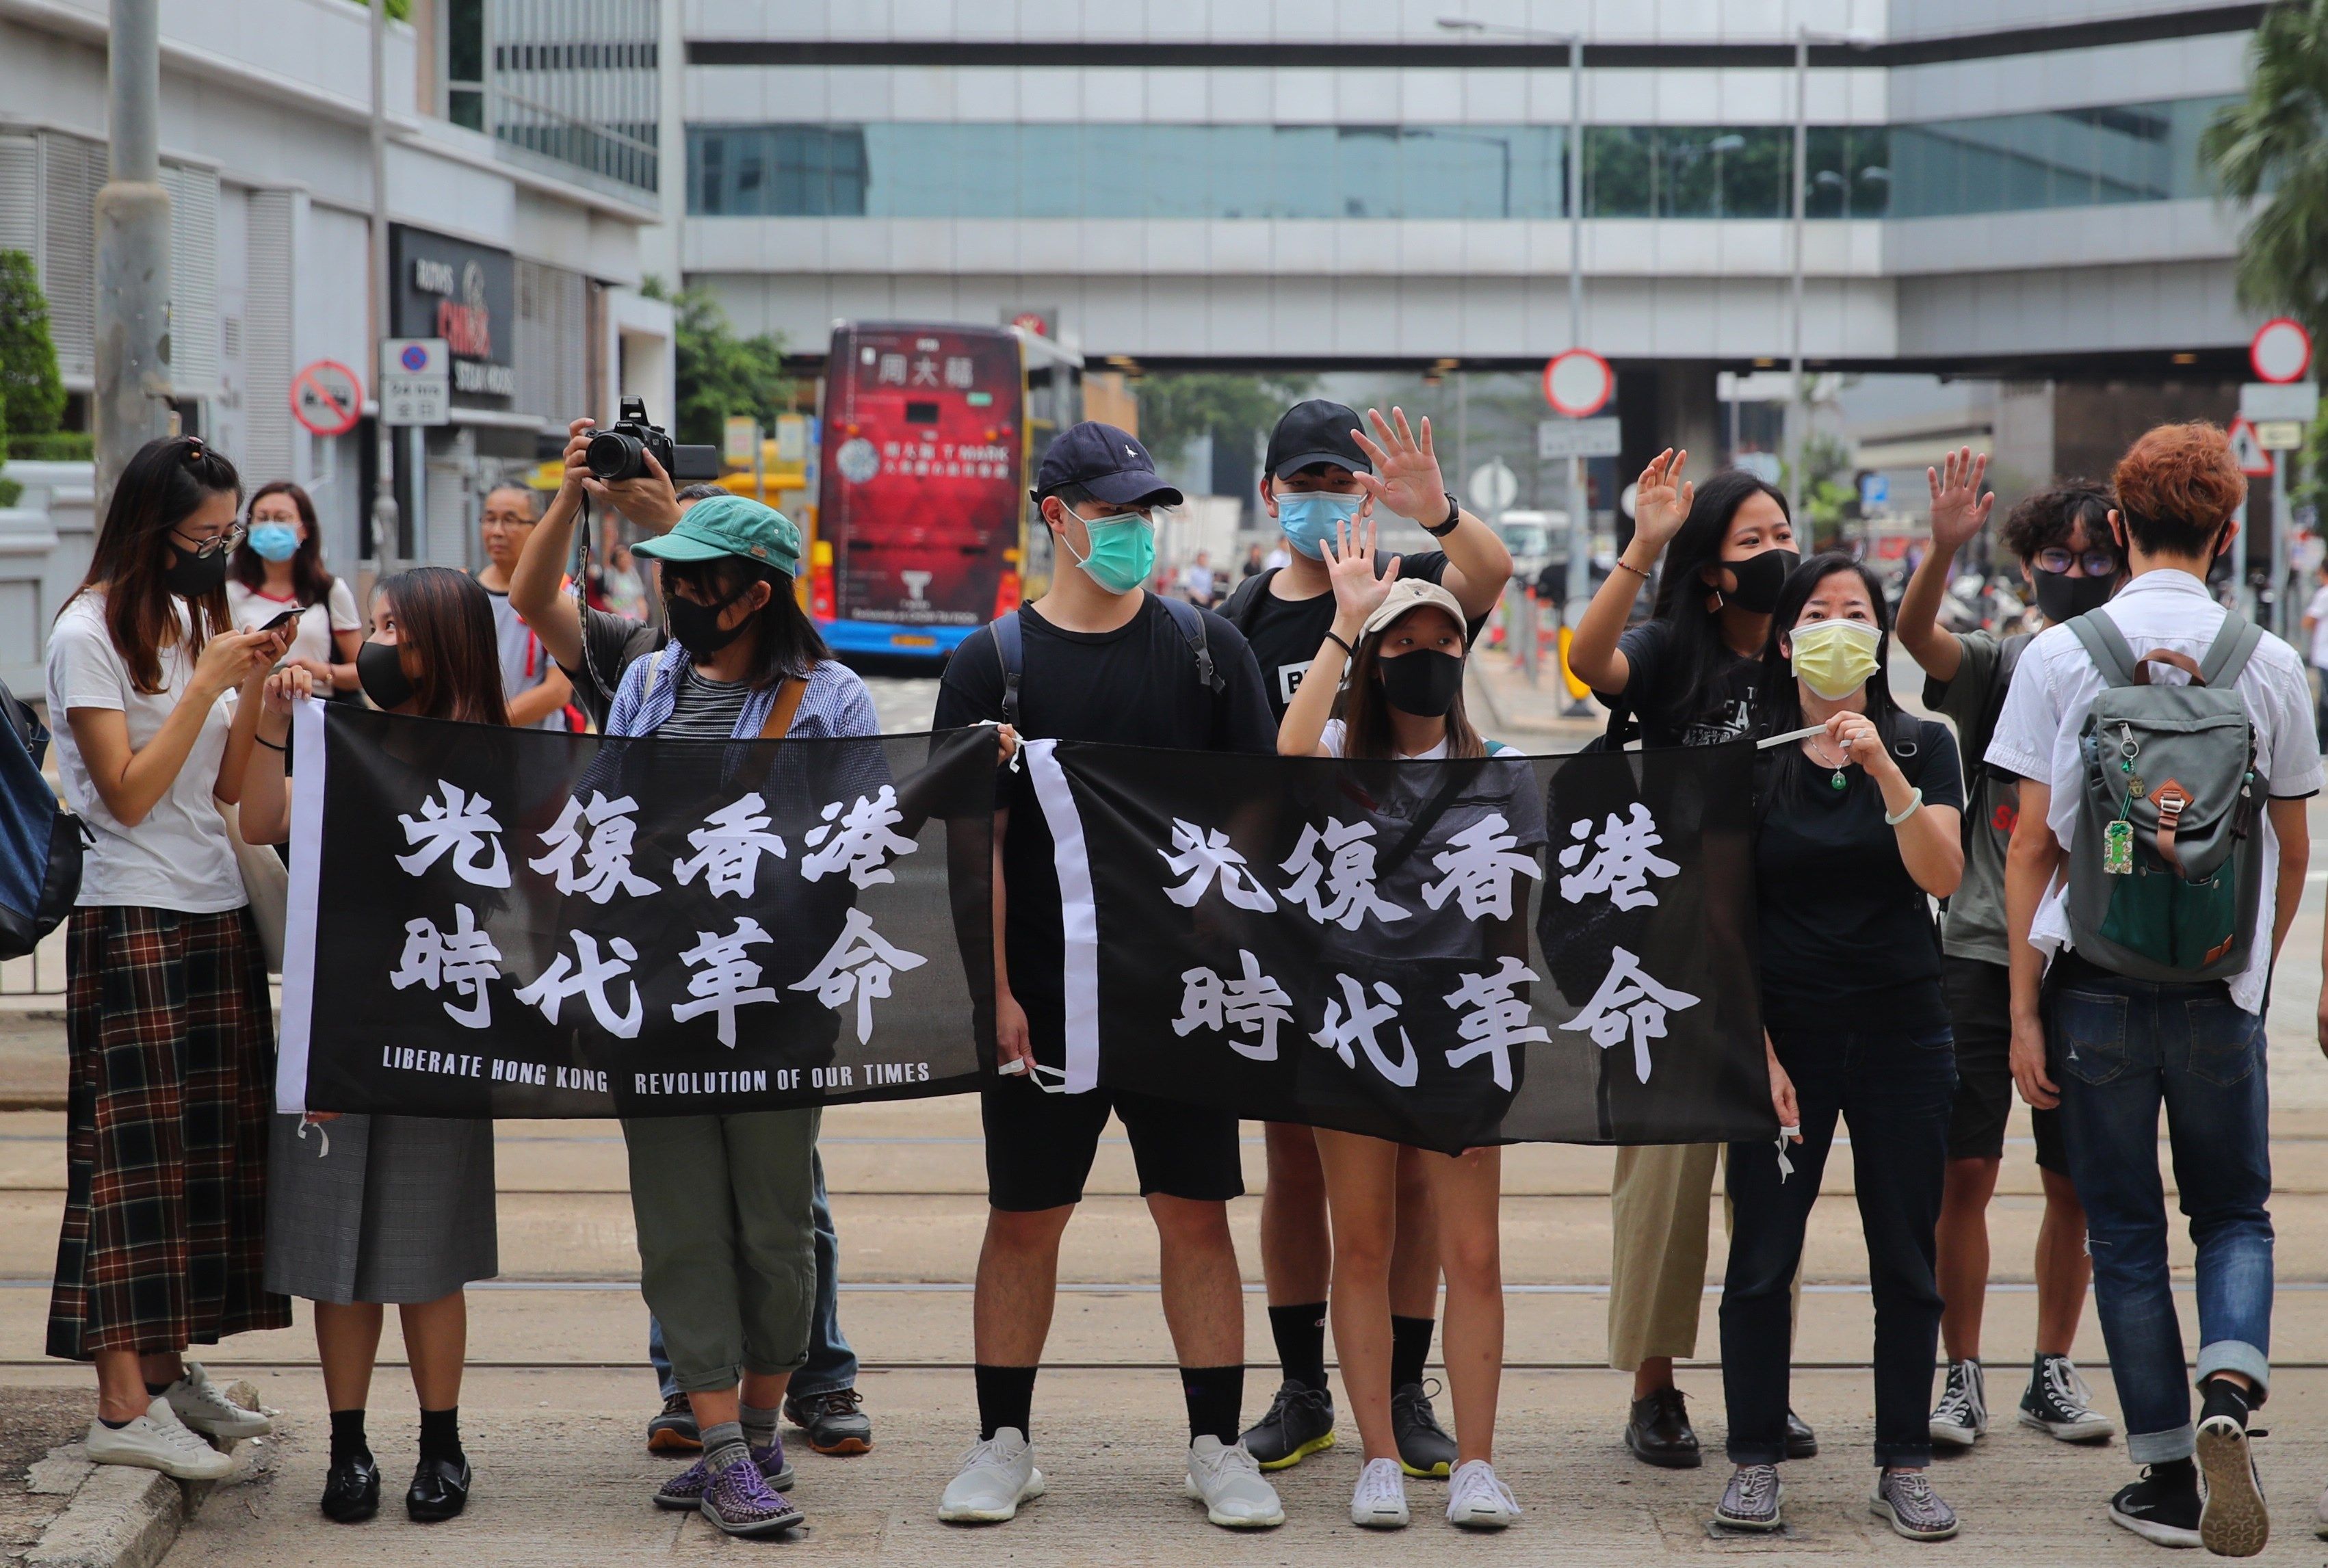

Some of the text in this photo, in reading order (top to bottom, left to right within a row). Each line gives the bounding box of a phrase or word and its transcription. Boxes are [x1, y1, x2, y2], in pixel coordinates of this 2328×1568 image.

[395, 779, 919, 904] 光復香港
[1157, 802, 1681, 931] 光復香港
[390, 904, 928, 1049] 時代革命
[1172, 946, 1701, 1092] 時代革命
[382, 1045, 930, 1094] LIBERATE HONG KONG REVOLUTION OF OUR TIMES
